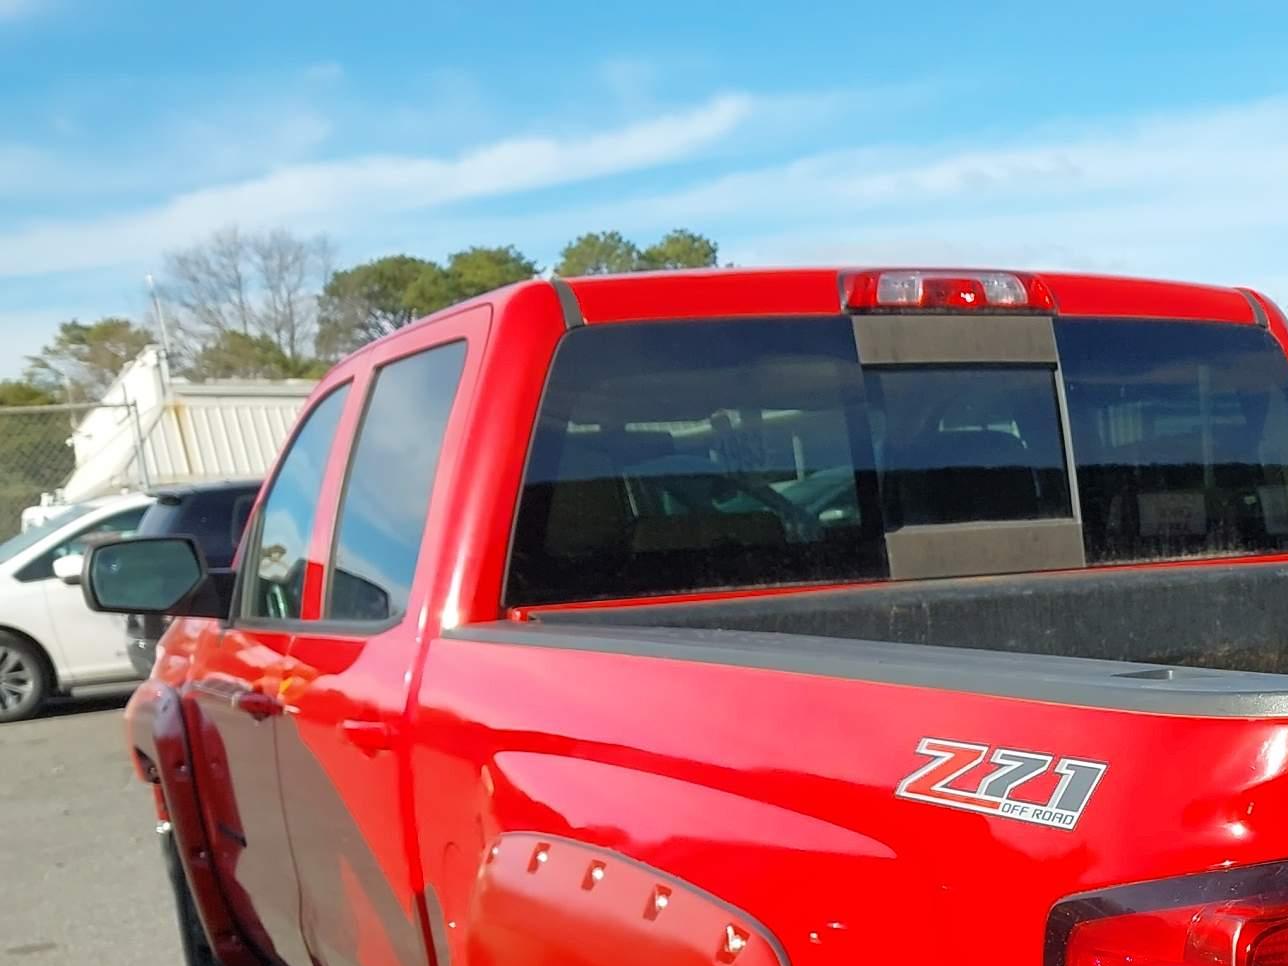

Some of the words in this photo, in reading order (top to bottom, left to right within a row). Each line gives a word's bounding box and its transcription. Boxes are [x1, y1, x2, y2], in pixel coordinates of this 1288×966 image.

[896, 737, 1107, 815] Z71
[1001, 801, 1028, 816] OFF
[1031, 808, 1075, 826] ROAD
